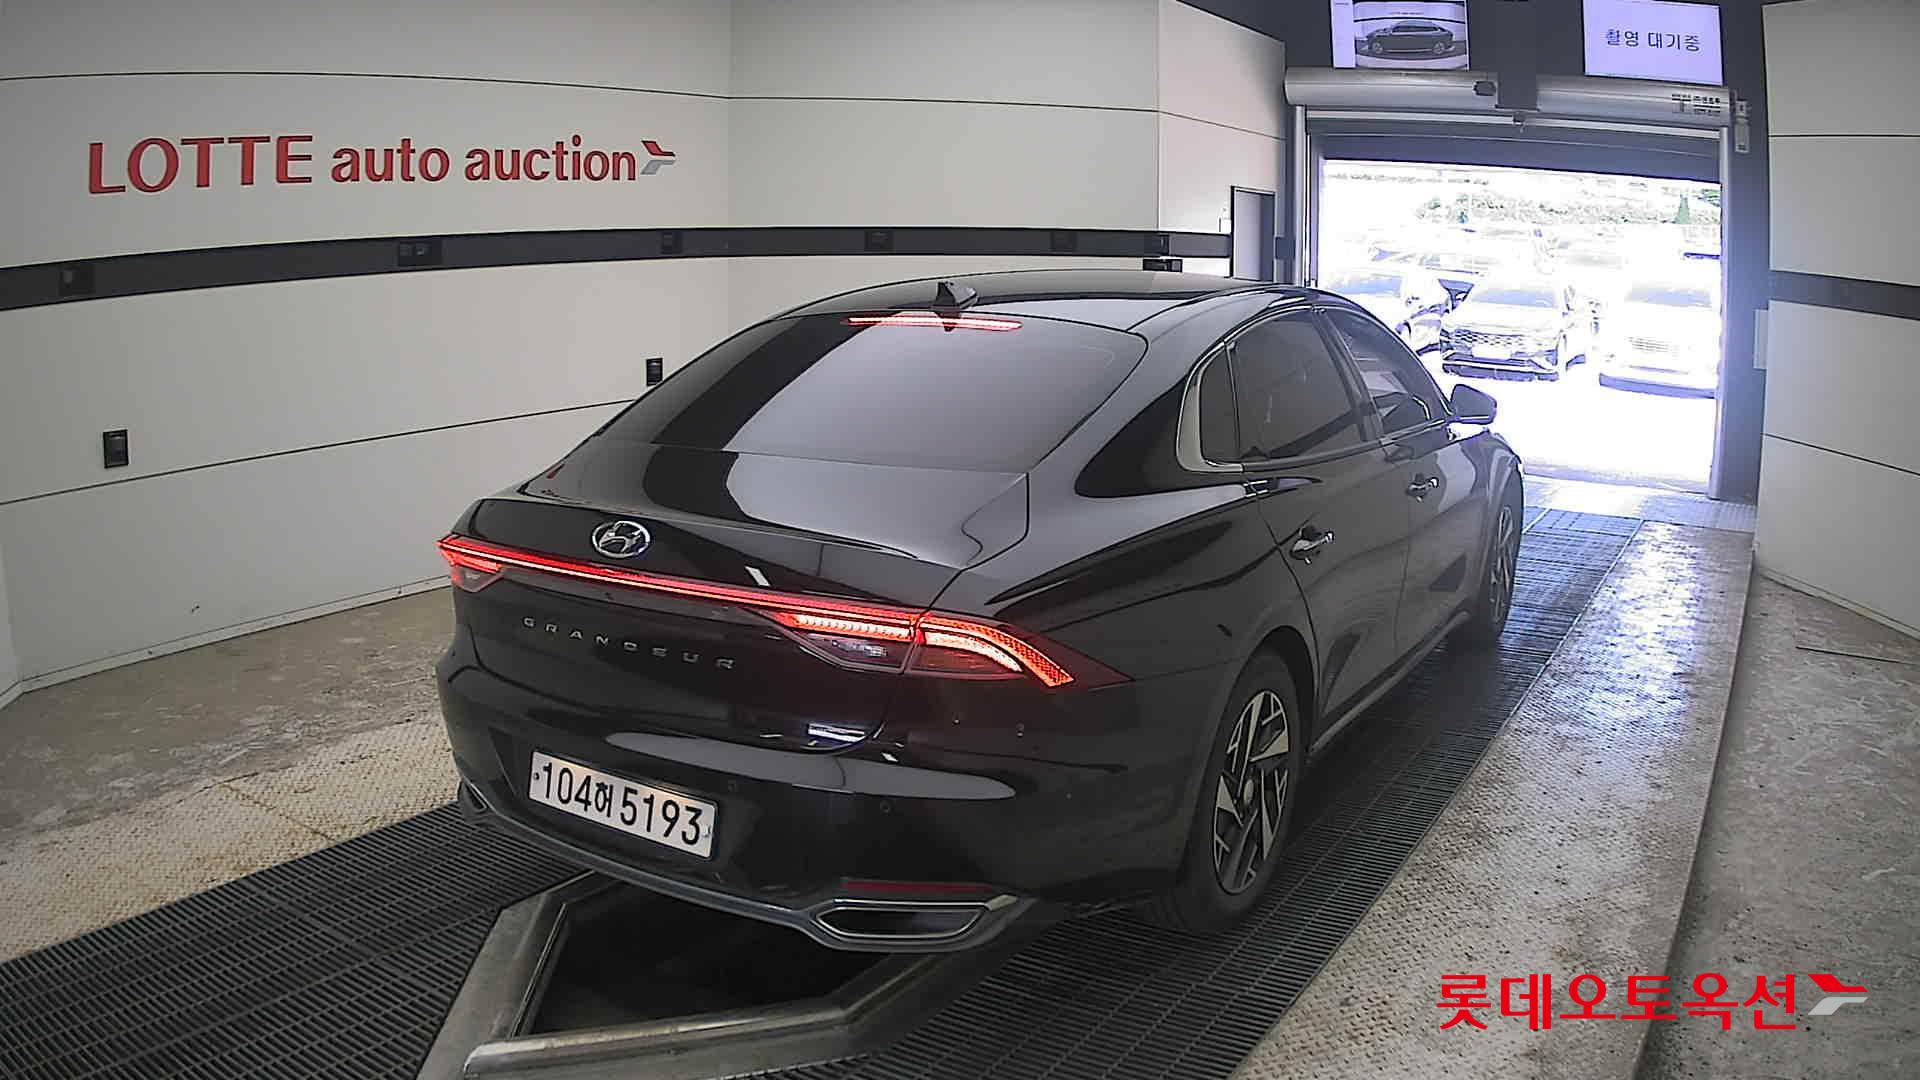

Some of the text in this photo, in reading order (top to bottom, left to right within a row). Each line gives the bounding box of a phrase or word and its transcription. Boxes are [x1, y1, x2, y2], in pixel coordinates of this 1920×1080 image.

[1648, 32, 1700, 52] 대기중
[89, 134, 637, 194] LOTTE auto auction
[523, 616, 735, 669] GRANDEUR
